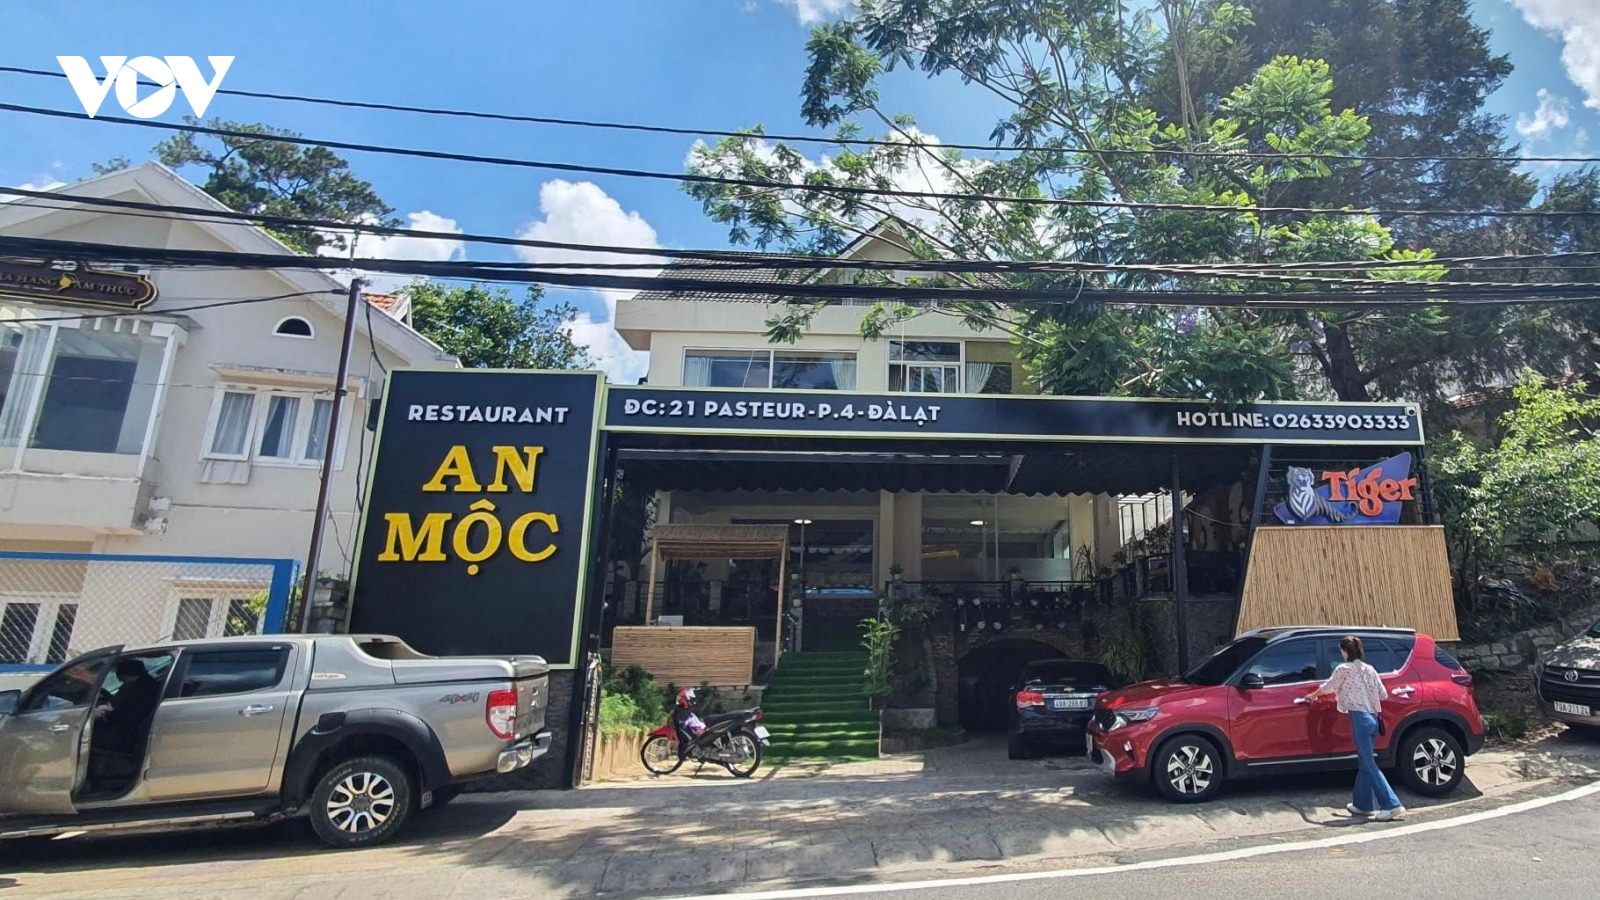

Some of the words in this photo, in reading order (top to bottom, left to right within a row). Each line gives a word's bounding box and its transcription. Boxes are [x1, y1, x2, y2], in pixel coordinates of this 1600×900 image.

[408, 405, 569, 424] RESTAURANT
[422, 445, 544, 493] AN
[1322, 467, 1417, 517] Tiger
[377, 498, 559, 576] MỘC
